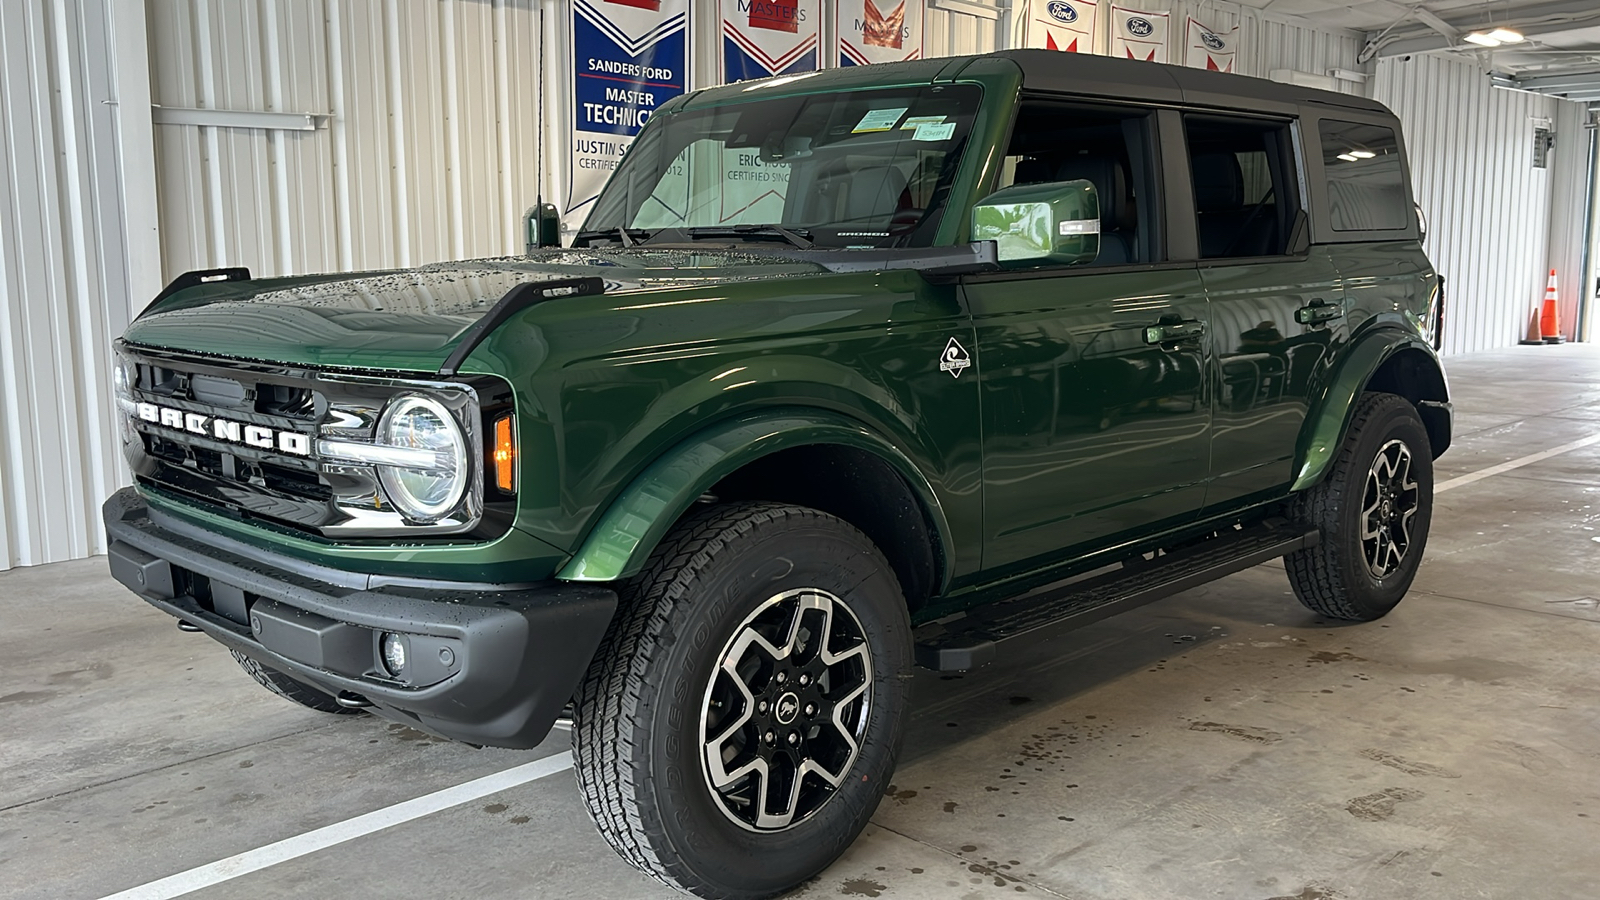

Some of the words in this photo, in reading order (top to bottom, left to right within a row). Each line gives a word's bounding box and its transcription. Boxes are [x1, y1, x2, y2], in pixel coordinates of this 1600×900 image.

[737, 0, 806, 22] MASTERS
[1051, 1, 1074, 20] Ford
[1129, 20, 1150, 35] Ford
[588, 58, 640, 77] SANDERS
[641, 66, 673, 80] FORD
[605, 87, 655, 106] MASTER
[583, 102, 653, 128] TECHNIC
[576, 139, 616, 156] JUSTIN
[739, 153, 762, 167] ERIC
[727, 170, 770, 182] CERTIFIED
[771, 172, 790, 183] SINC
[138, 401, 311, 456] BRONCO
